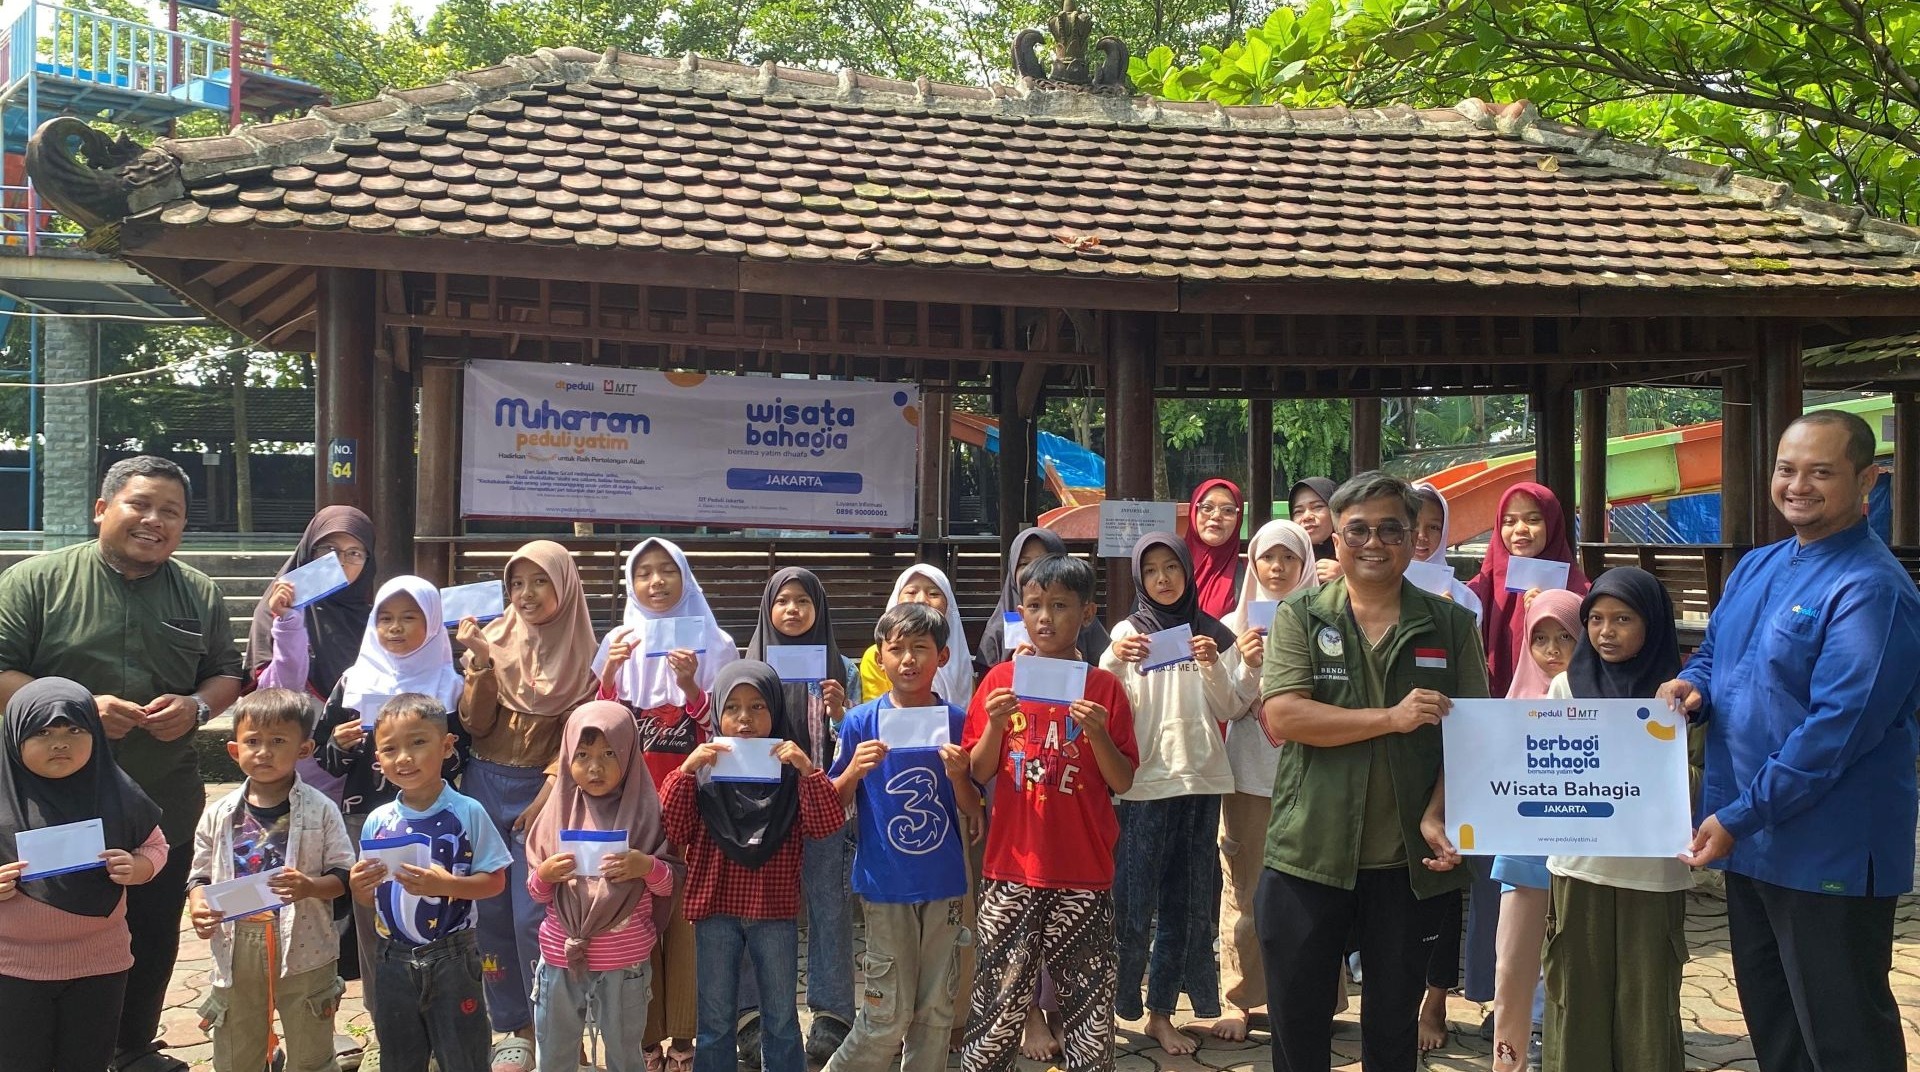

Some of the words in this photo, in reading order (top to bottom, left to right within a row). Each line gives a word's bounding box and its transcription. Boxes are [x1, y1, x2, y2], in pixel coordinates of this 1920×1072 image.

[615, 383, 638, 393] MTT
[495, 397, 650, 434] Muharram
[746, 397, 855, 427] wisata
[516, 430, 571, 451] peduli
[573, 432, 628, 454] yatim
[746, 423, 848, 457] bahagia
[334, 445, 353, 455] NO.
[727, 448, 759, 456] bersama
[761, 449, 781, 458] yatim
[783, 449, 808, 458] dhuafa
[332, 461, 352, 478] 64
[765, 474, 824, 487] JAKARTA
[1578, 709, 1599, 718] MTT
[637, 715, 692, 752] Hijab
[668, 735, 688, 748] love
[1526, 734, 1599, 757] berbagi
[1527, 752, 1600, 774] bahagia
[1490, 780, 1558, 797] Wisata
[1564, 781, 1641, 800] Bahagia
[1543, 804, 1588, 814] JAKARTA
